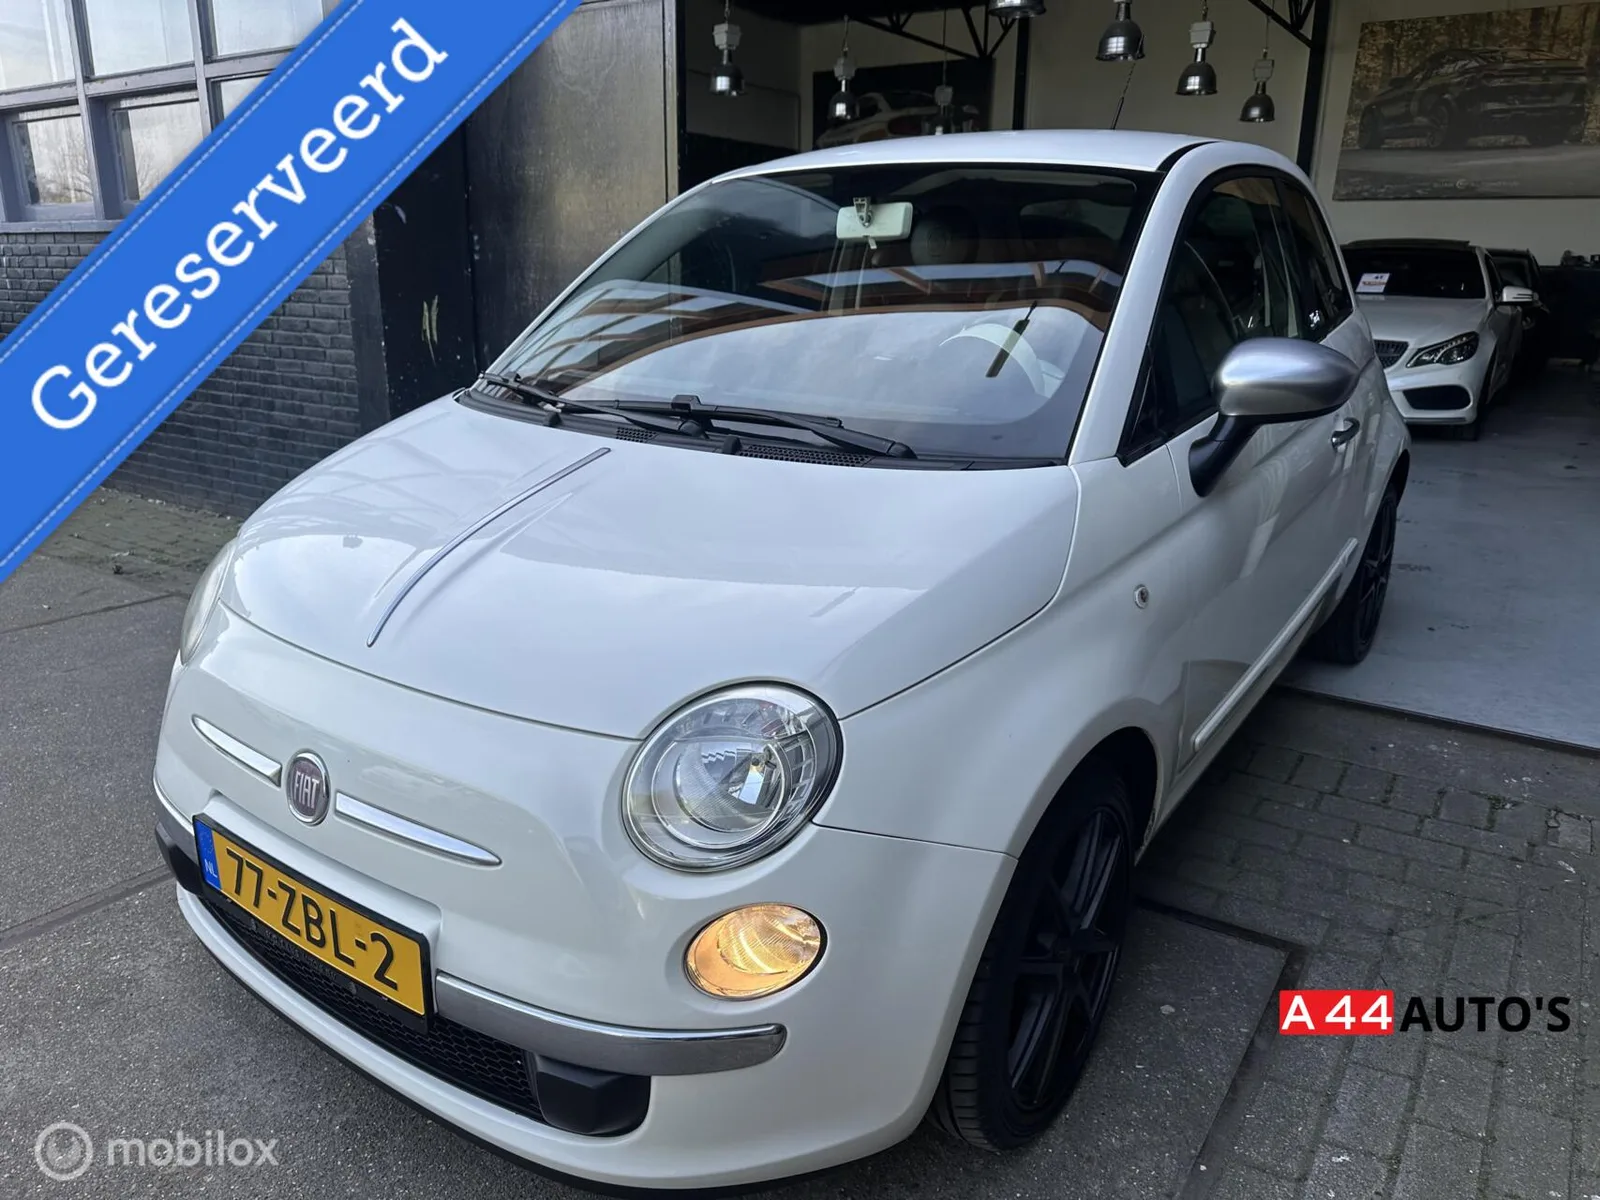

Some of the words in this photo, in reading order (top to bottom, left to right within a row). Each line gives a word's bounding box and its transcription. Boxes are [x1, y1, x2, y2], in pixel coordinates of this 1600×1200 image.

[294, 770, 320, 809] FIAT
[204, 858, 218, 879] NL
[225, 846, 399, 992] 77-ZBL-2
